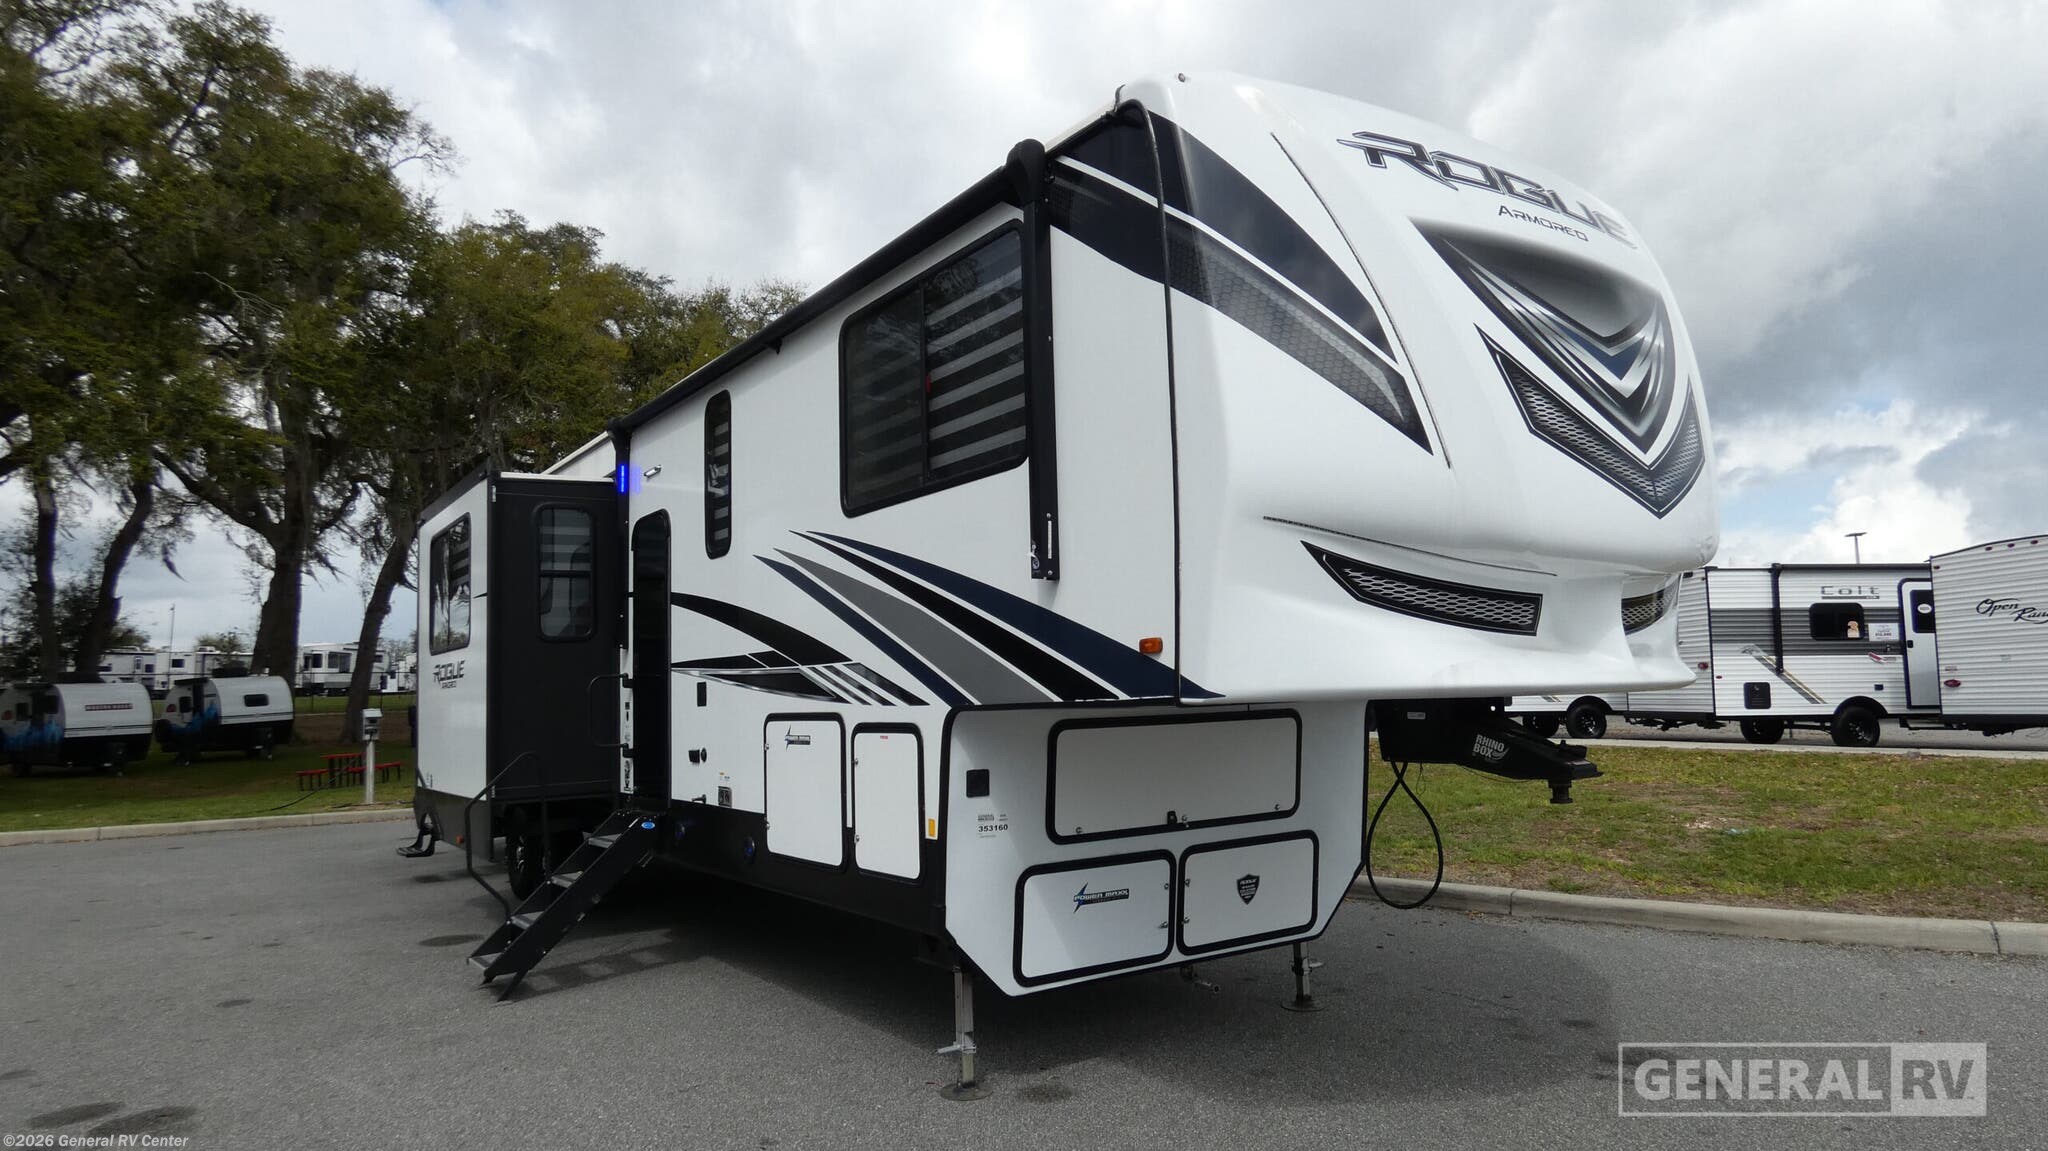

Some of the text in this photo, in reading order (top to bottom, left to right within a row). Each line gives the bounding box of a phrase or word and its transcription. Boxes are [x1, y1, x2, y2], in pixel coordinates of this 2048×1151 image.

[1336, 131, 1638, 249] ROGUE
[1498, 205, 1589, 242] ARMORED
[1821, 585, 1880, 595] Colt
[1976, 598, 2020, 617] Open
[2010, 607, 2048, 625] Ran
[432, 659, 465, 684] ROGUE
[1473, 743, 1493, 758] BOX
[1476, 734, 1505, 752] RHINO
[978, 823, 1009, 832] 353160
